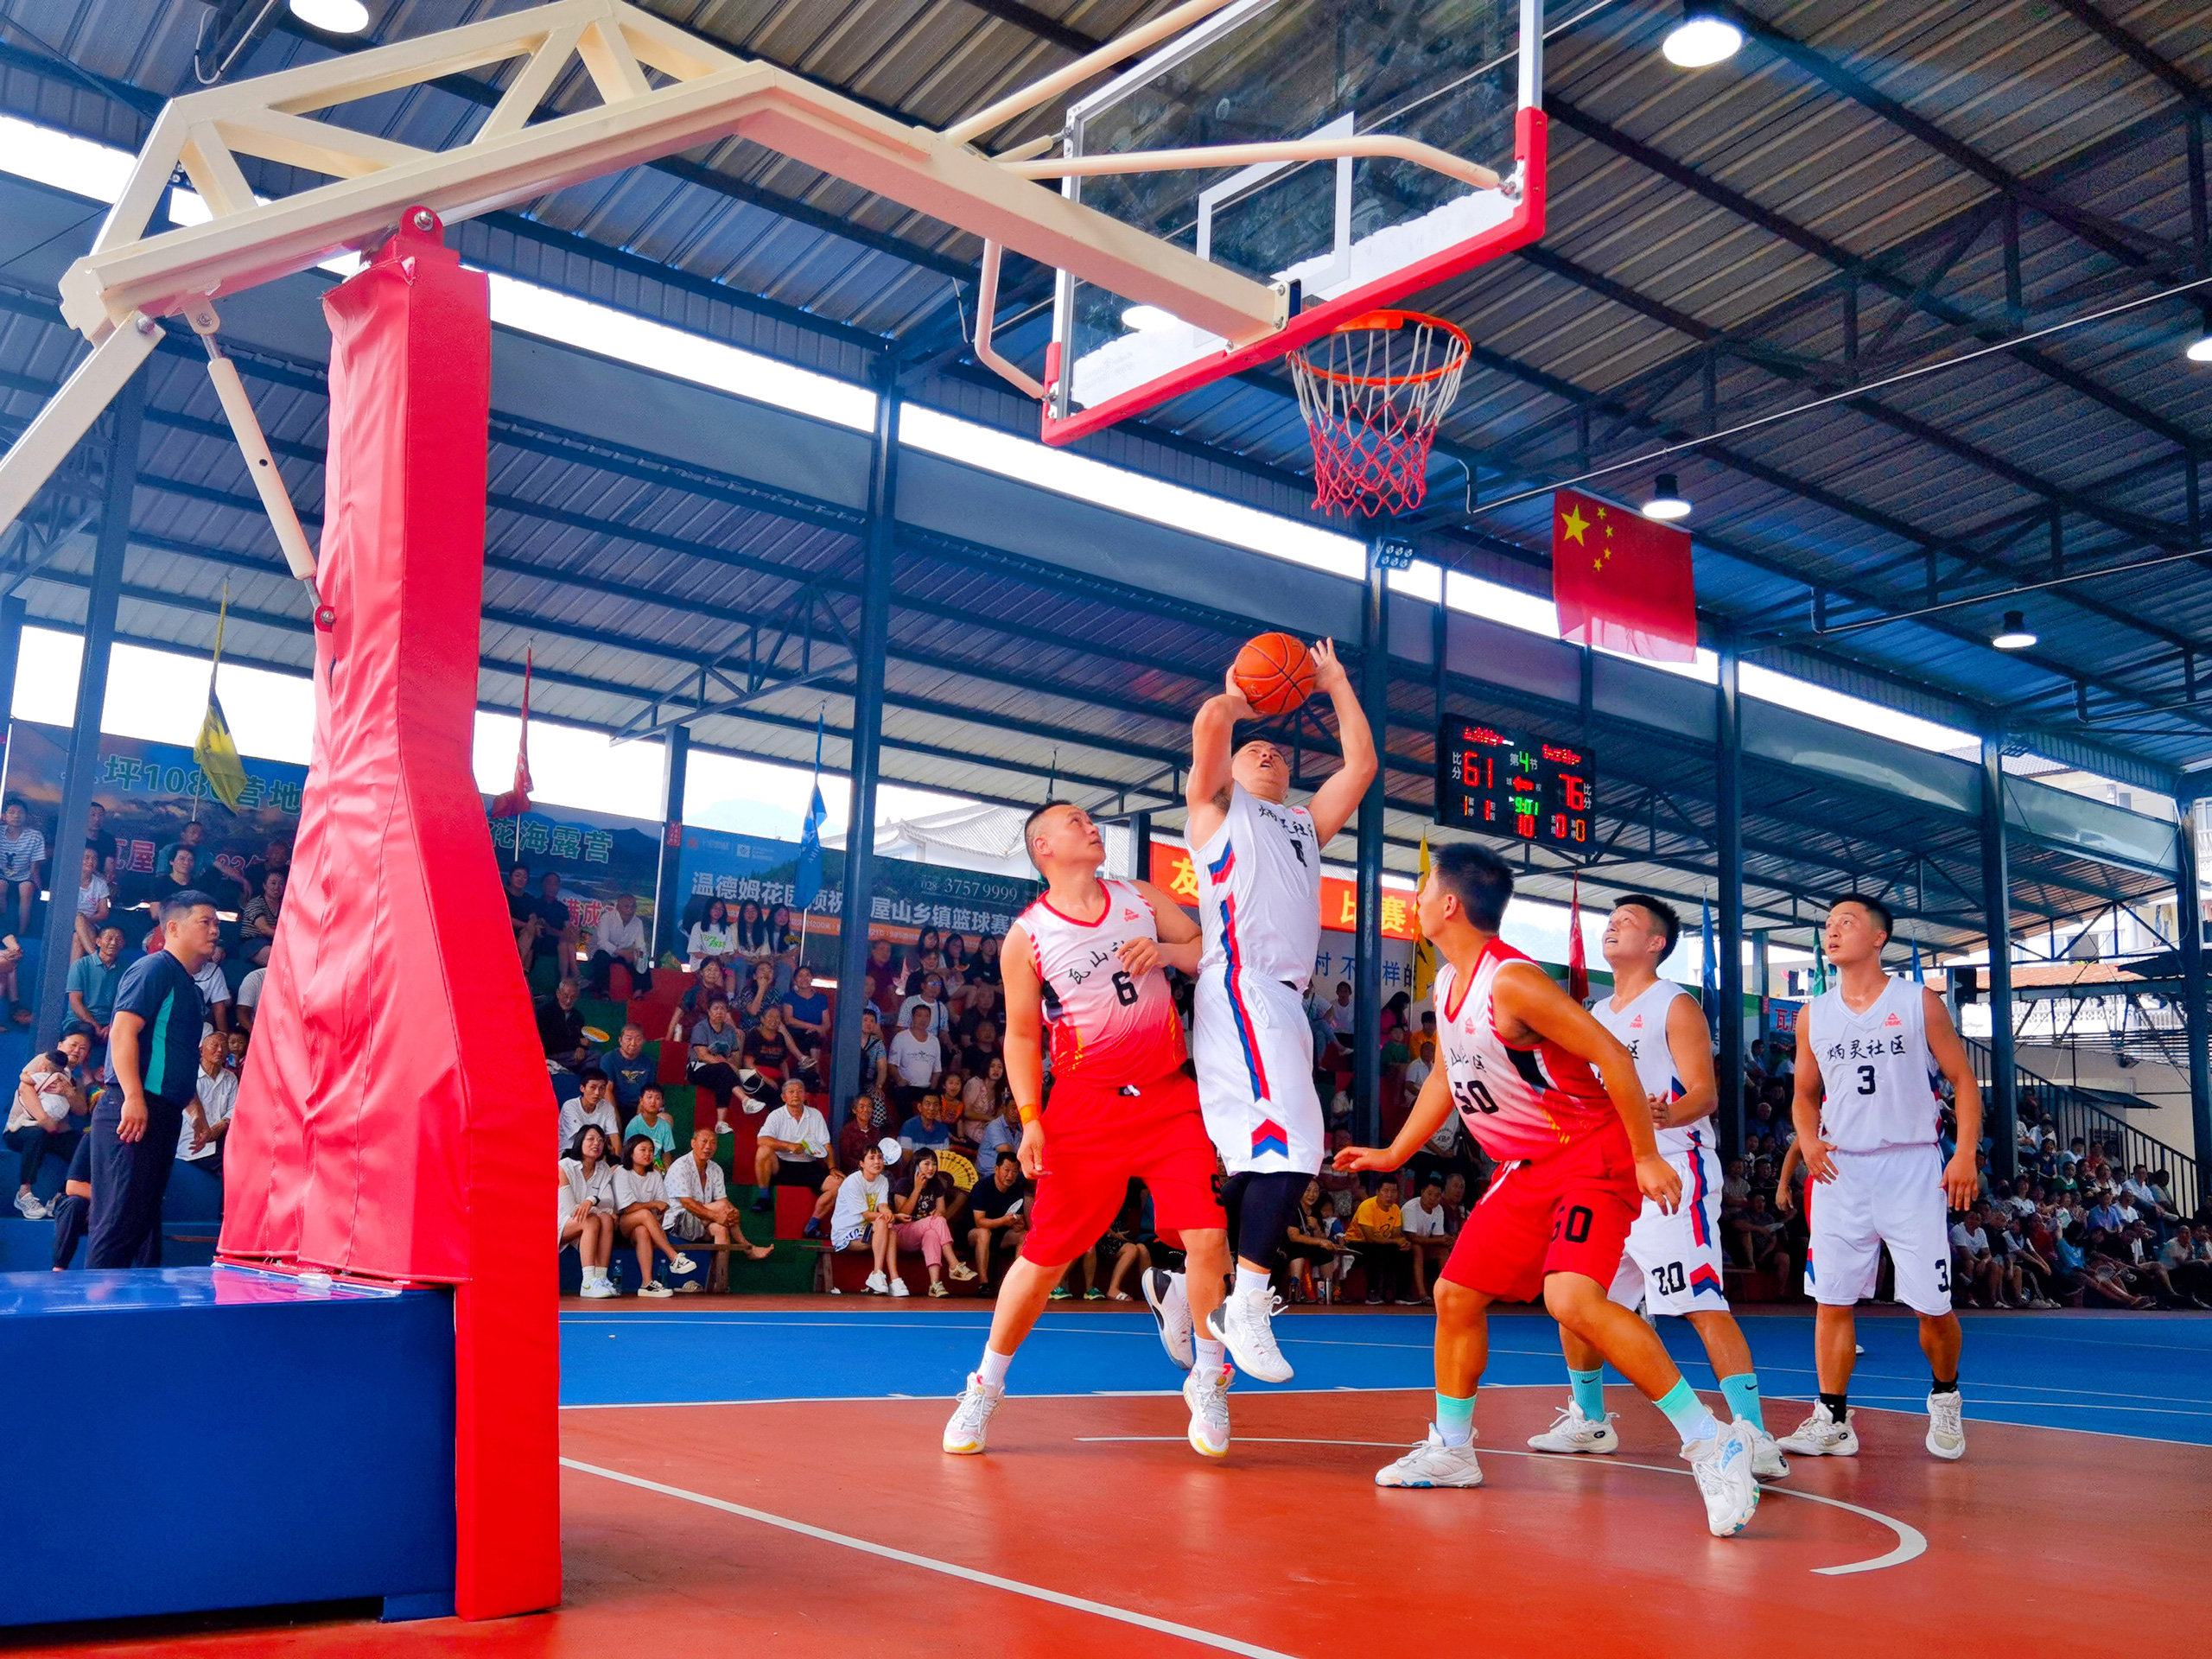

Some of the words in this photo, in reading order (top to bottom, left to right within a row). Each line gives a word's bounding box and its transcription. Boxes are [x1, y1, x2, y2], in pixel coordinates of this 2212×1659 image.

[1452, 751, 1462, 779] 比分
[1462, 750, 1493, 789] 61
[97, 753, 302, 816] 坪108营地
[1559, 773, 1585, 810] 76
[1583, 783, 1592, 810] 比分
[944, 878, 980, 897] 3757
[982, 883, 1018, 902] 9999
[1339, 890, 1417, 934] 比赛
[1111, 969, 1139, 1007] 6
[1827, 1034, 1906, 1062] 炳灵社区
[1453, 1079, 1500, 1116] 50
[1857, 1065, 1876, 1096] 3
[1650, 1261, 1687, 1296] 20
[1935, 1258, 1949, 1294] 3
